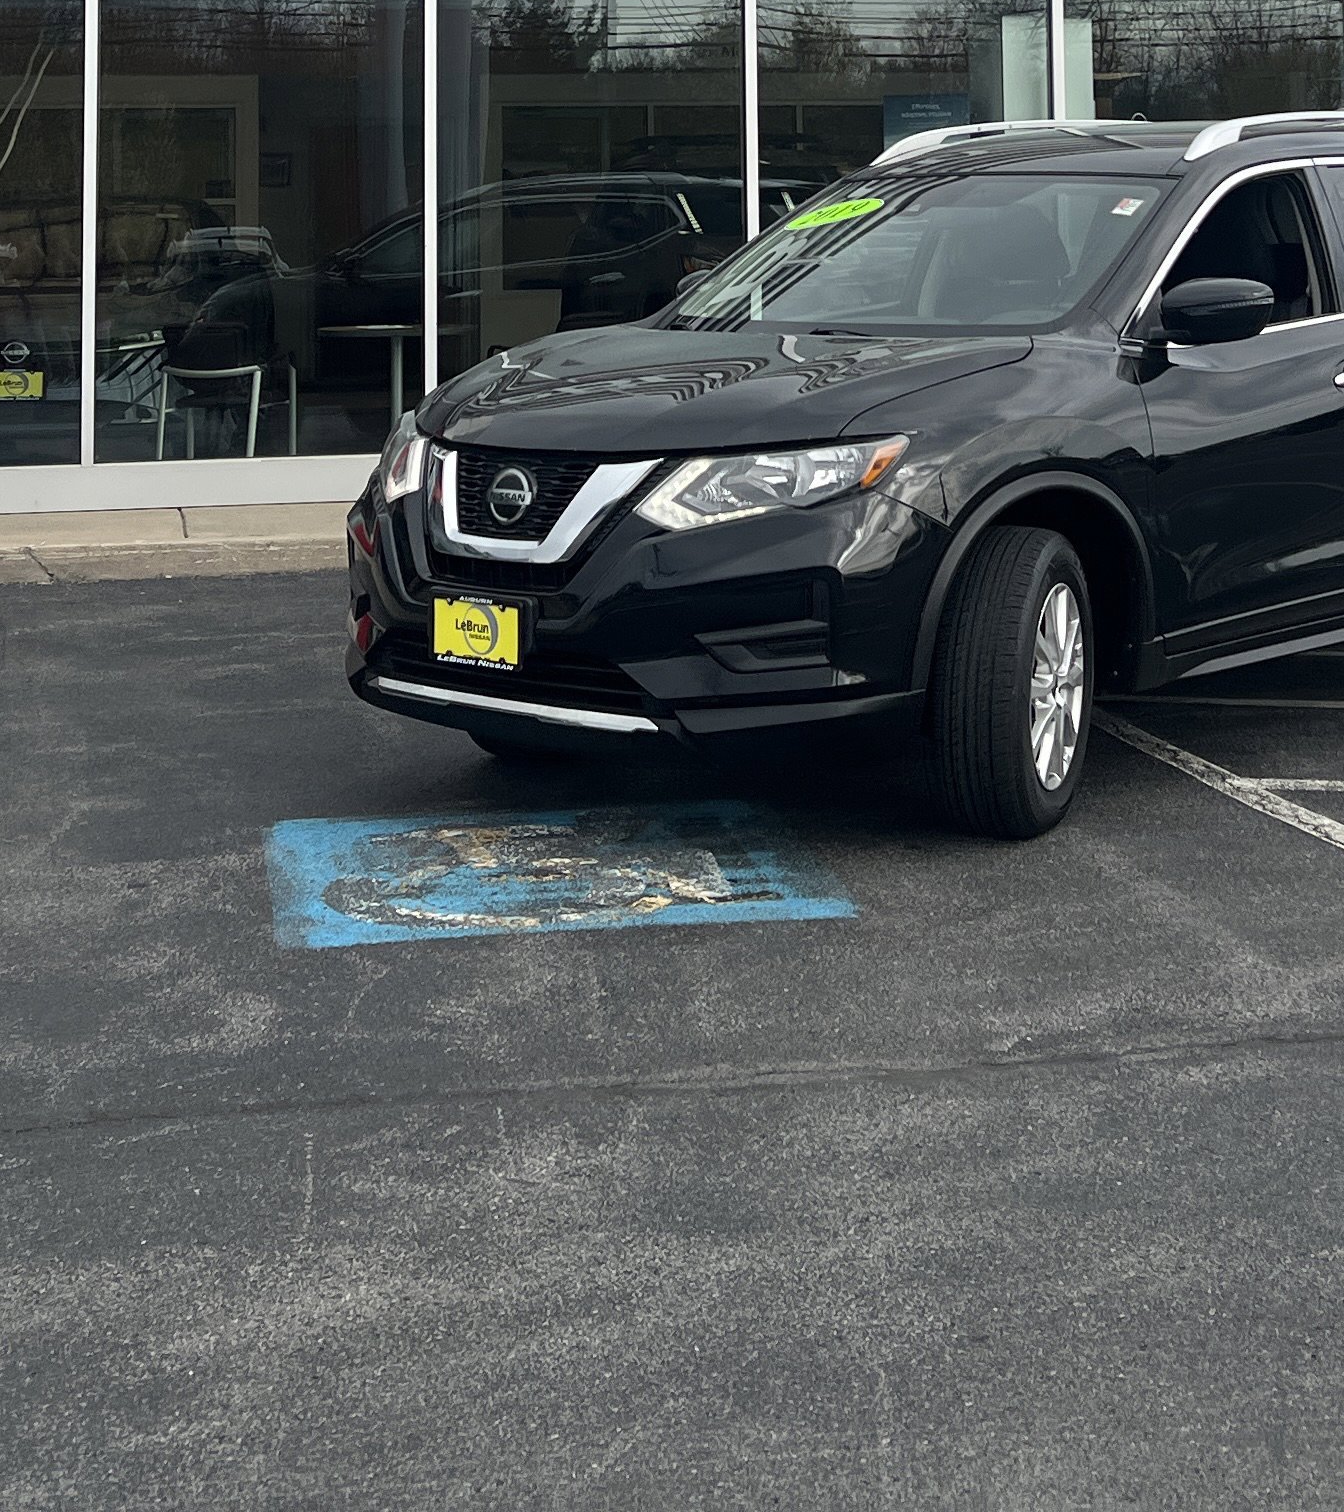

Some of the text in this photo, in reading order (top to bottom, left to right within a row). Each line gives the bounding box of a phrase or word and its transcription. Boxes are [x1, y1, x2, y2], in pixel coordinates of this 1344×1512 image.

[459, 595, 493, 605] AUBURN
[455, 618, 489, 634] LeBrun
[477, 659, 514, 671] NISSAN
